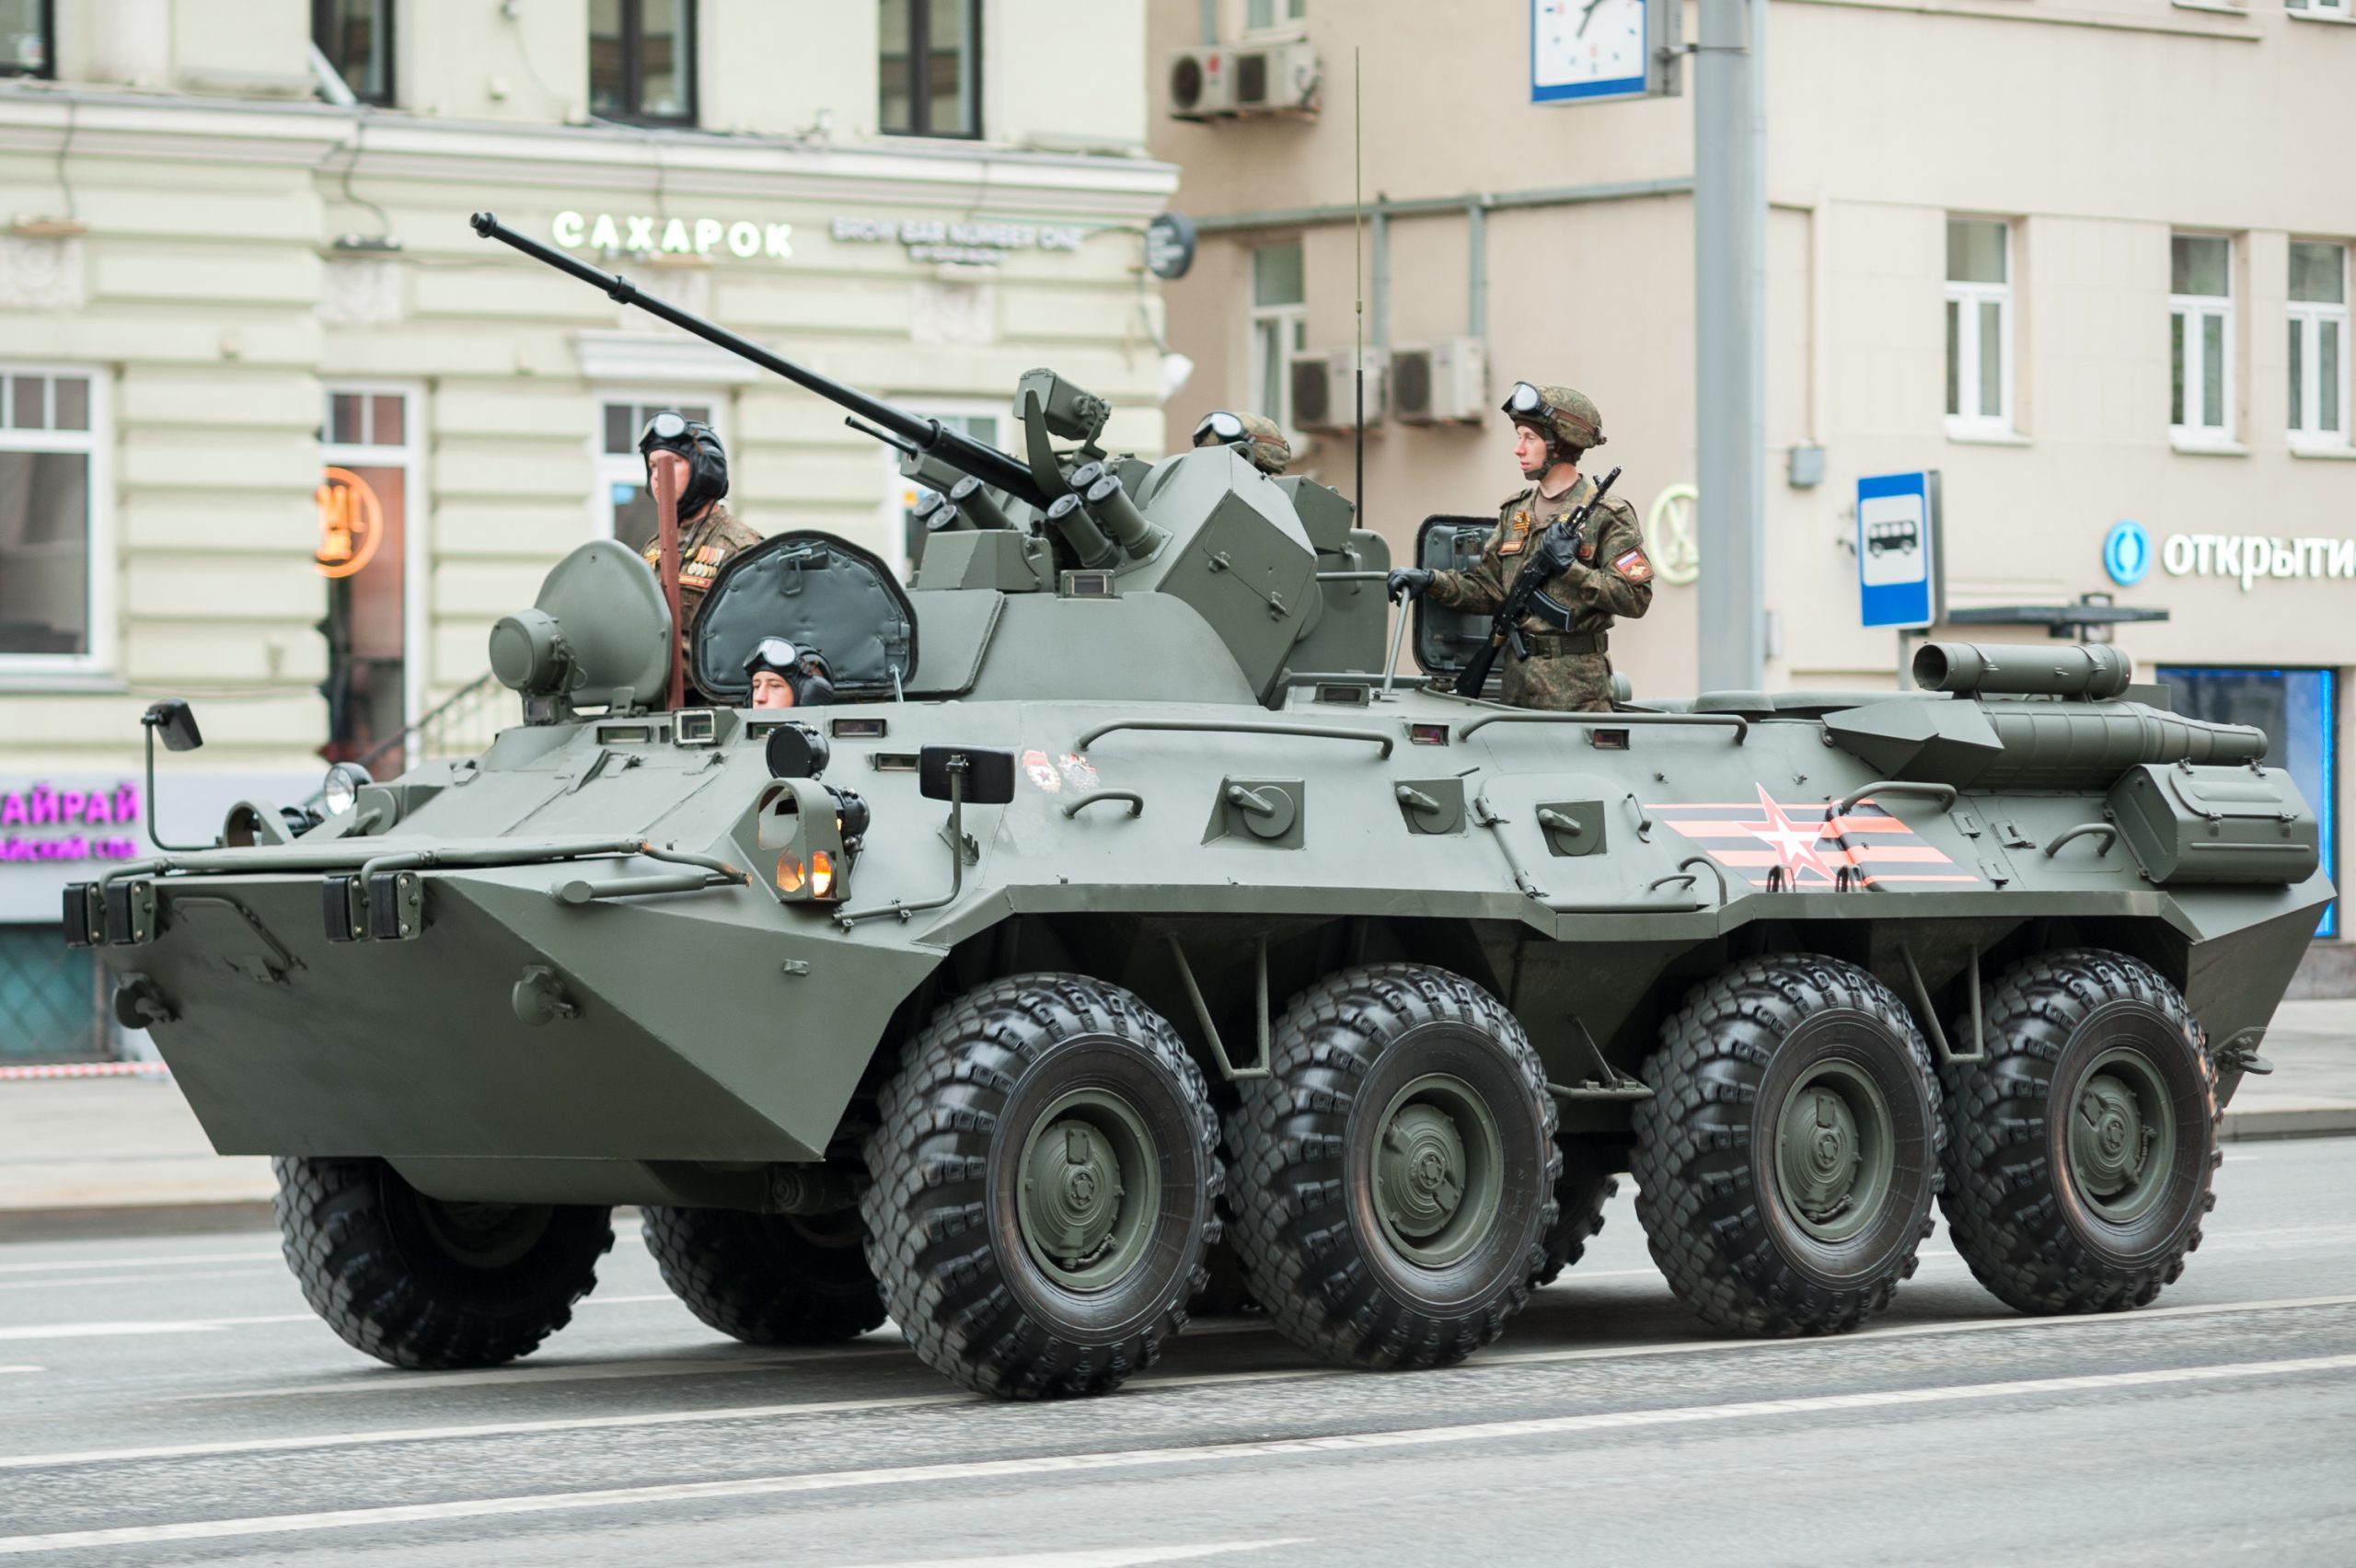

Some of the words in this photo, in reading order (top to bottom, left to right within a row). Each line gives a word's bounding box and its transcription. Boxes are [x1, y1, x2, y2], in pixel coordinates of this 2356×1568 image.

[552, 210, 794, 259] САХАРОК
[2163, 533, 2356, 592] открыти
[0, 781, 140, 825] АЙРАЙ
